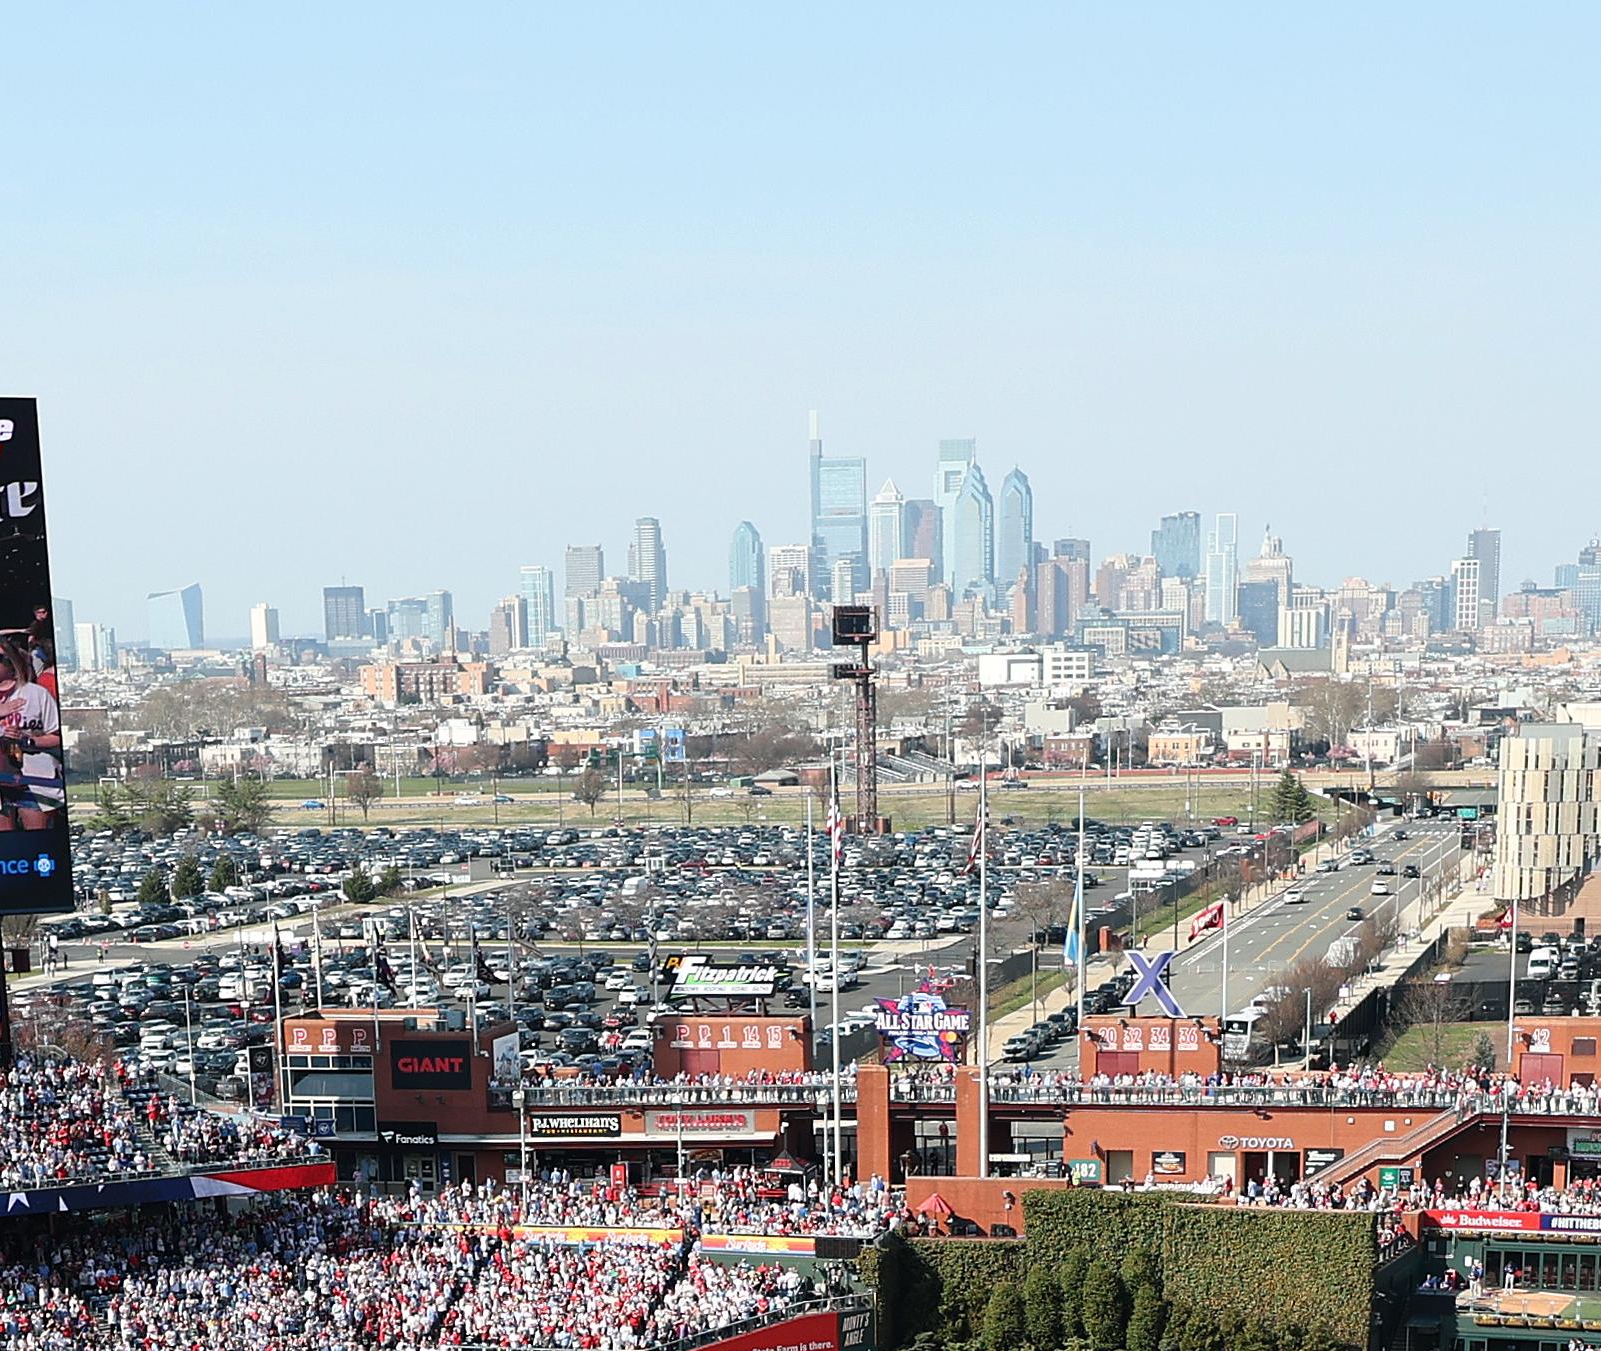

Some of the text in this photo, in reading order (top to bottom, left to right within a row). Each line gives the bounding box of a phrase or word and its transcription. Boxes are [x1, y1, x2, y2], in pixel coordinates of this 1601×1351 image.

[934, 1011, 970, 1031] GAME
[397, 1056, 464, 1073] GIANT
[395, 1132, 435, 1145] Fanatics
[1240, 1137, 1294, 1149] TOYOTA
[1459, 1213, 1523, 1228] Budweiser
[800, 1343, 808, 1351] is
[809, 1340, 834, 1351] there.
